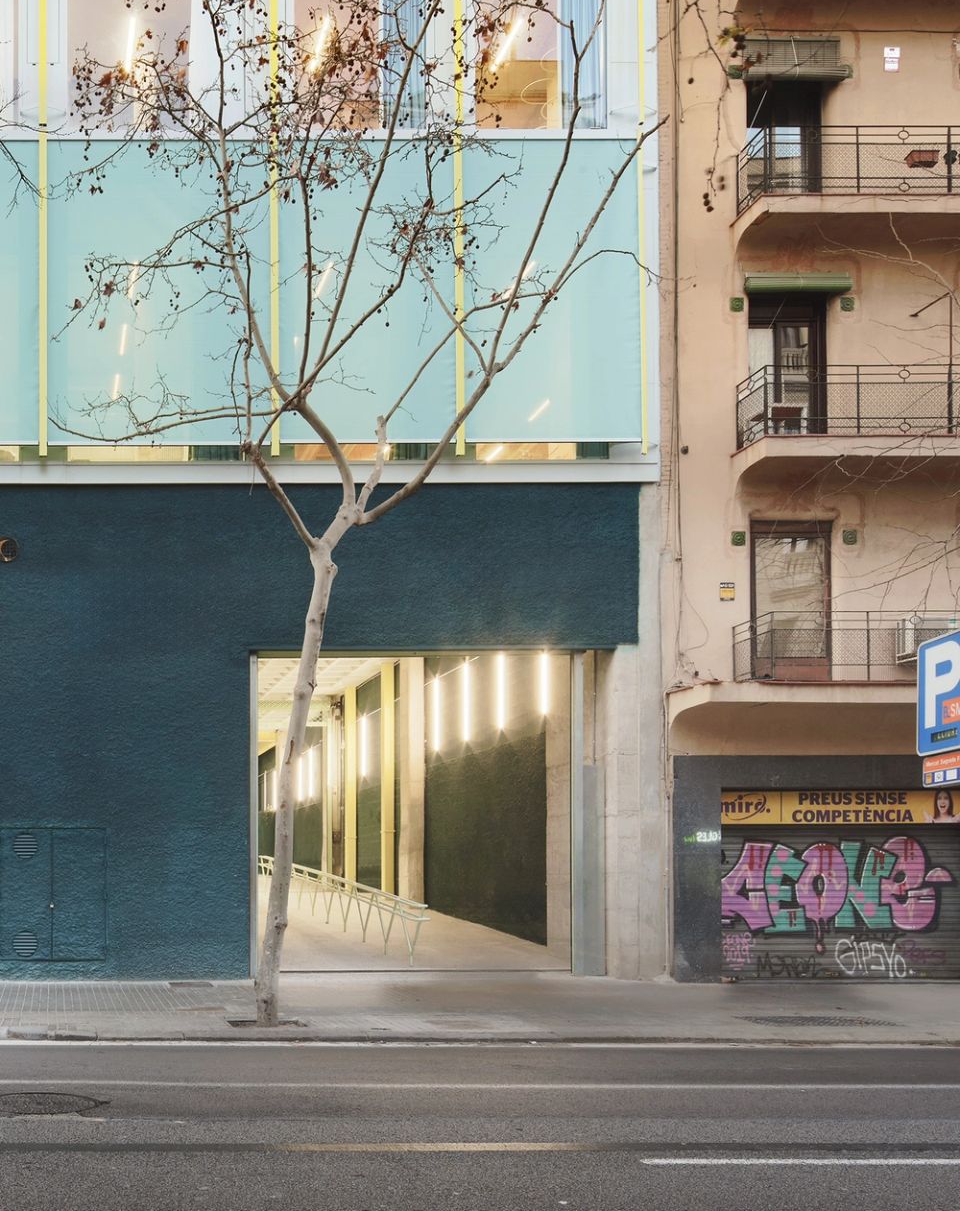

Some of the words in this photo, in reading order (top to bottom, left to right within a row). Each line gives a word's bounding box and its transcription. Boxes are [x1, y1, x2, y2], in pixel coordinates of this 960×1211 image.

[925, 640, 960, 729] P
[799, 792, 852, 806] PREUS
[855, 792, 907, 805] SENSE
[792, 806, 914, 823] COMPETÈNCIA
